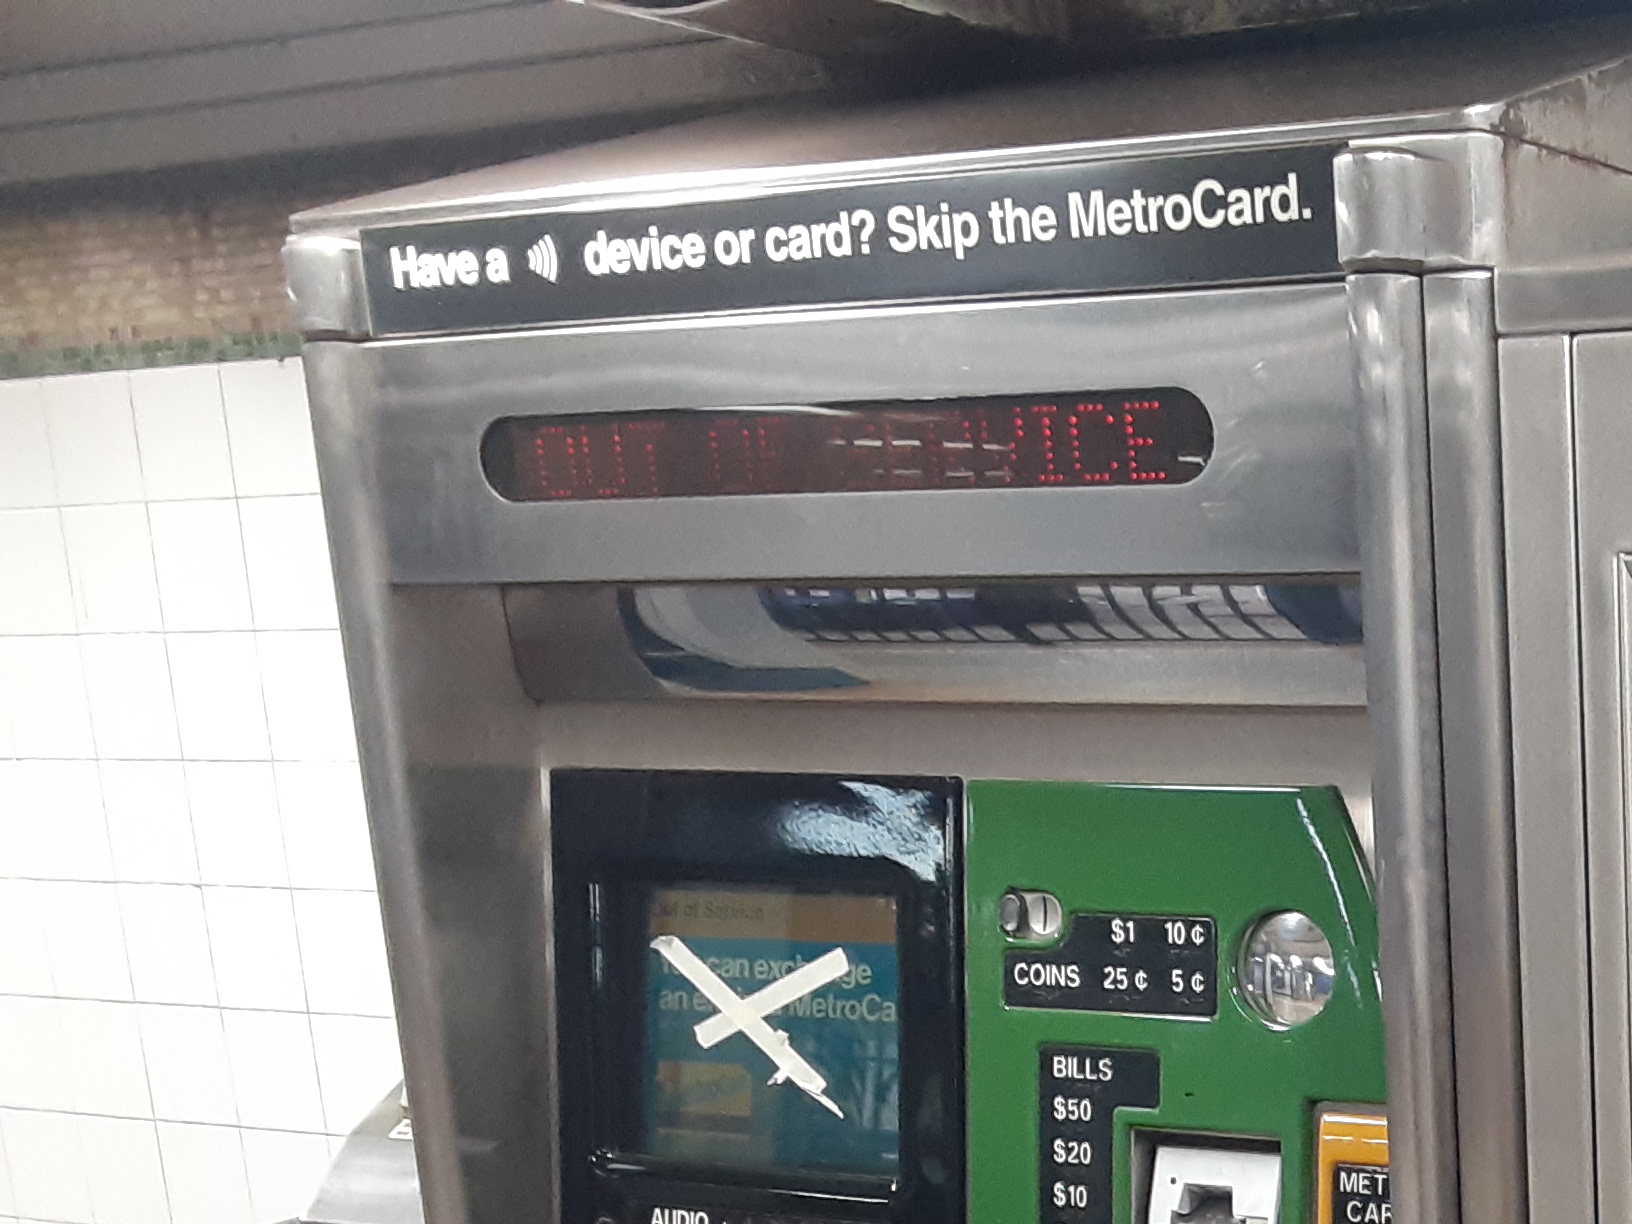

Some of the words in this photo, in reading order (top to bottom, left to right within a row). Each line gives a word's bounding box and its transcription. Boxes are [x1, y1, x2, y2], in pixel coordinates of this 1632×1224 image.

[389, 245, 479, 290] Have
[485, 248, 509, 283] a
[583, 225, 706, 276] device
[713, 227, 756, 265] or
[764, 208, 875, 263] card?
[888, 203, 979, 259] Skip
[988, 198, 1057, 246] the
[1067, 172, 1314, 239] MetroCard.
[534, 421, 666, 496] OUT
[1110, 917, 1136, 945] $1
[705, 956, 750, 978] can
[1014, 961, 1081, 988] COINS
[1052, 1055, 1113, 1082] BILLS
[1053, 1094, 1092, 1122] $50
[1053, 1138, 1092, 1165] $20
[1053, 1180, 1088, 1209] $10
[1340, 1171, 1387, 1195] MET
